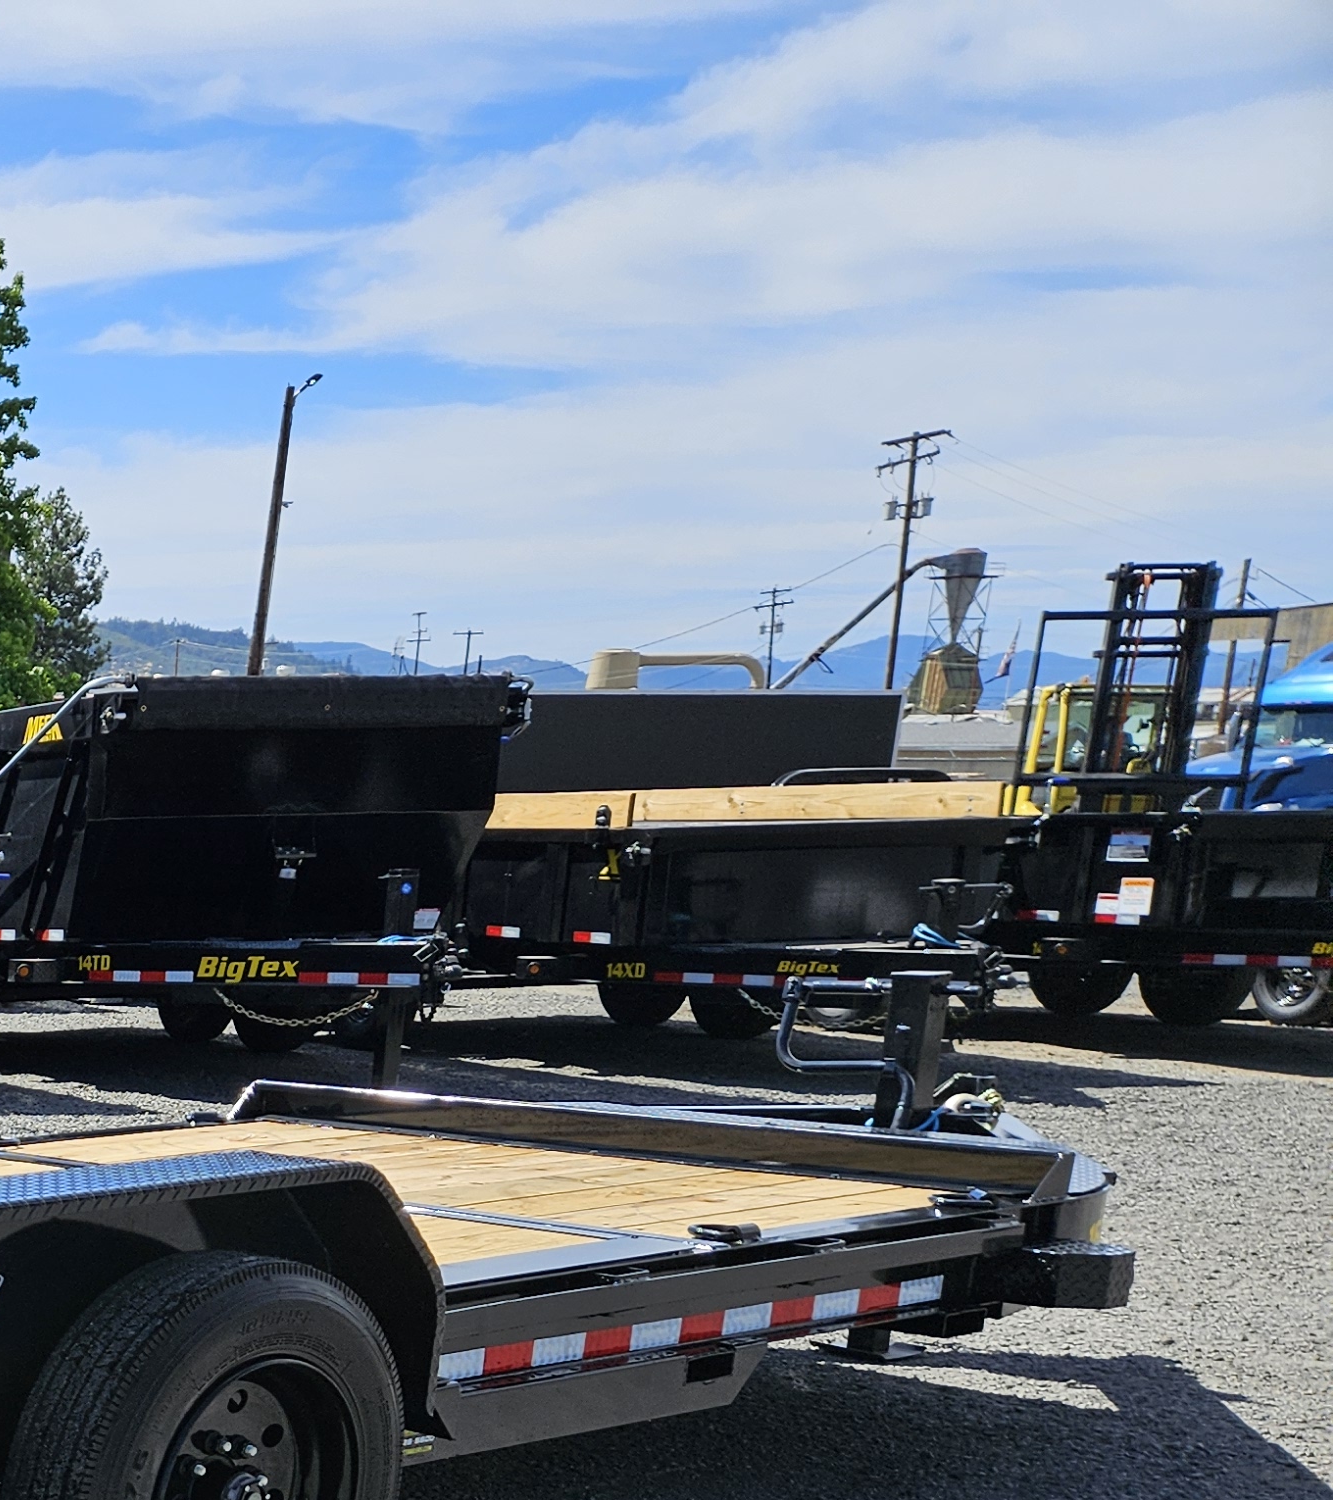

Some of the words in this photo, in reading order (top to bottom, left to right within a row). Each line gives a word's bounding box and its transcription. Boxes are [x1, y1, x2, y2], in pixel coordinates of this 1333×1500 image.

[77, 955, 111, 971] 14TD
[196, 956, 300, 983] BigTex
[605, 962, 646, 979] 14XD
[776, 960, 841, 976] BigTex
